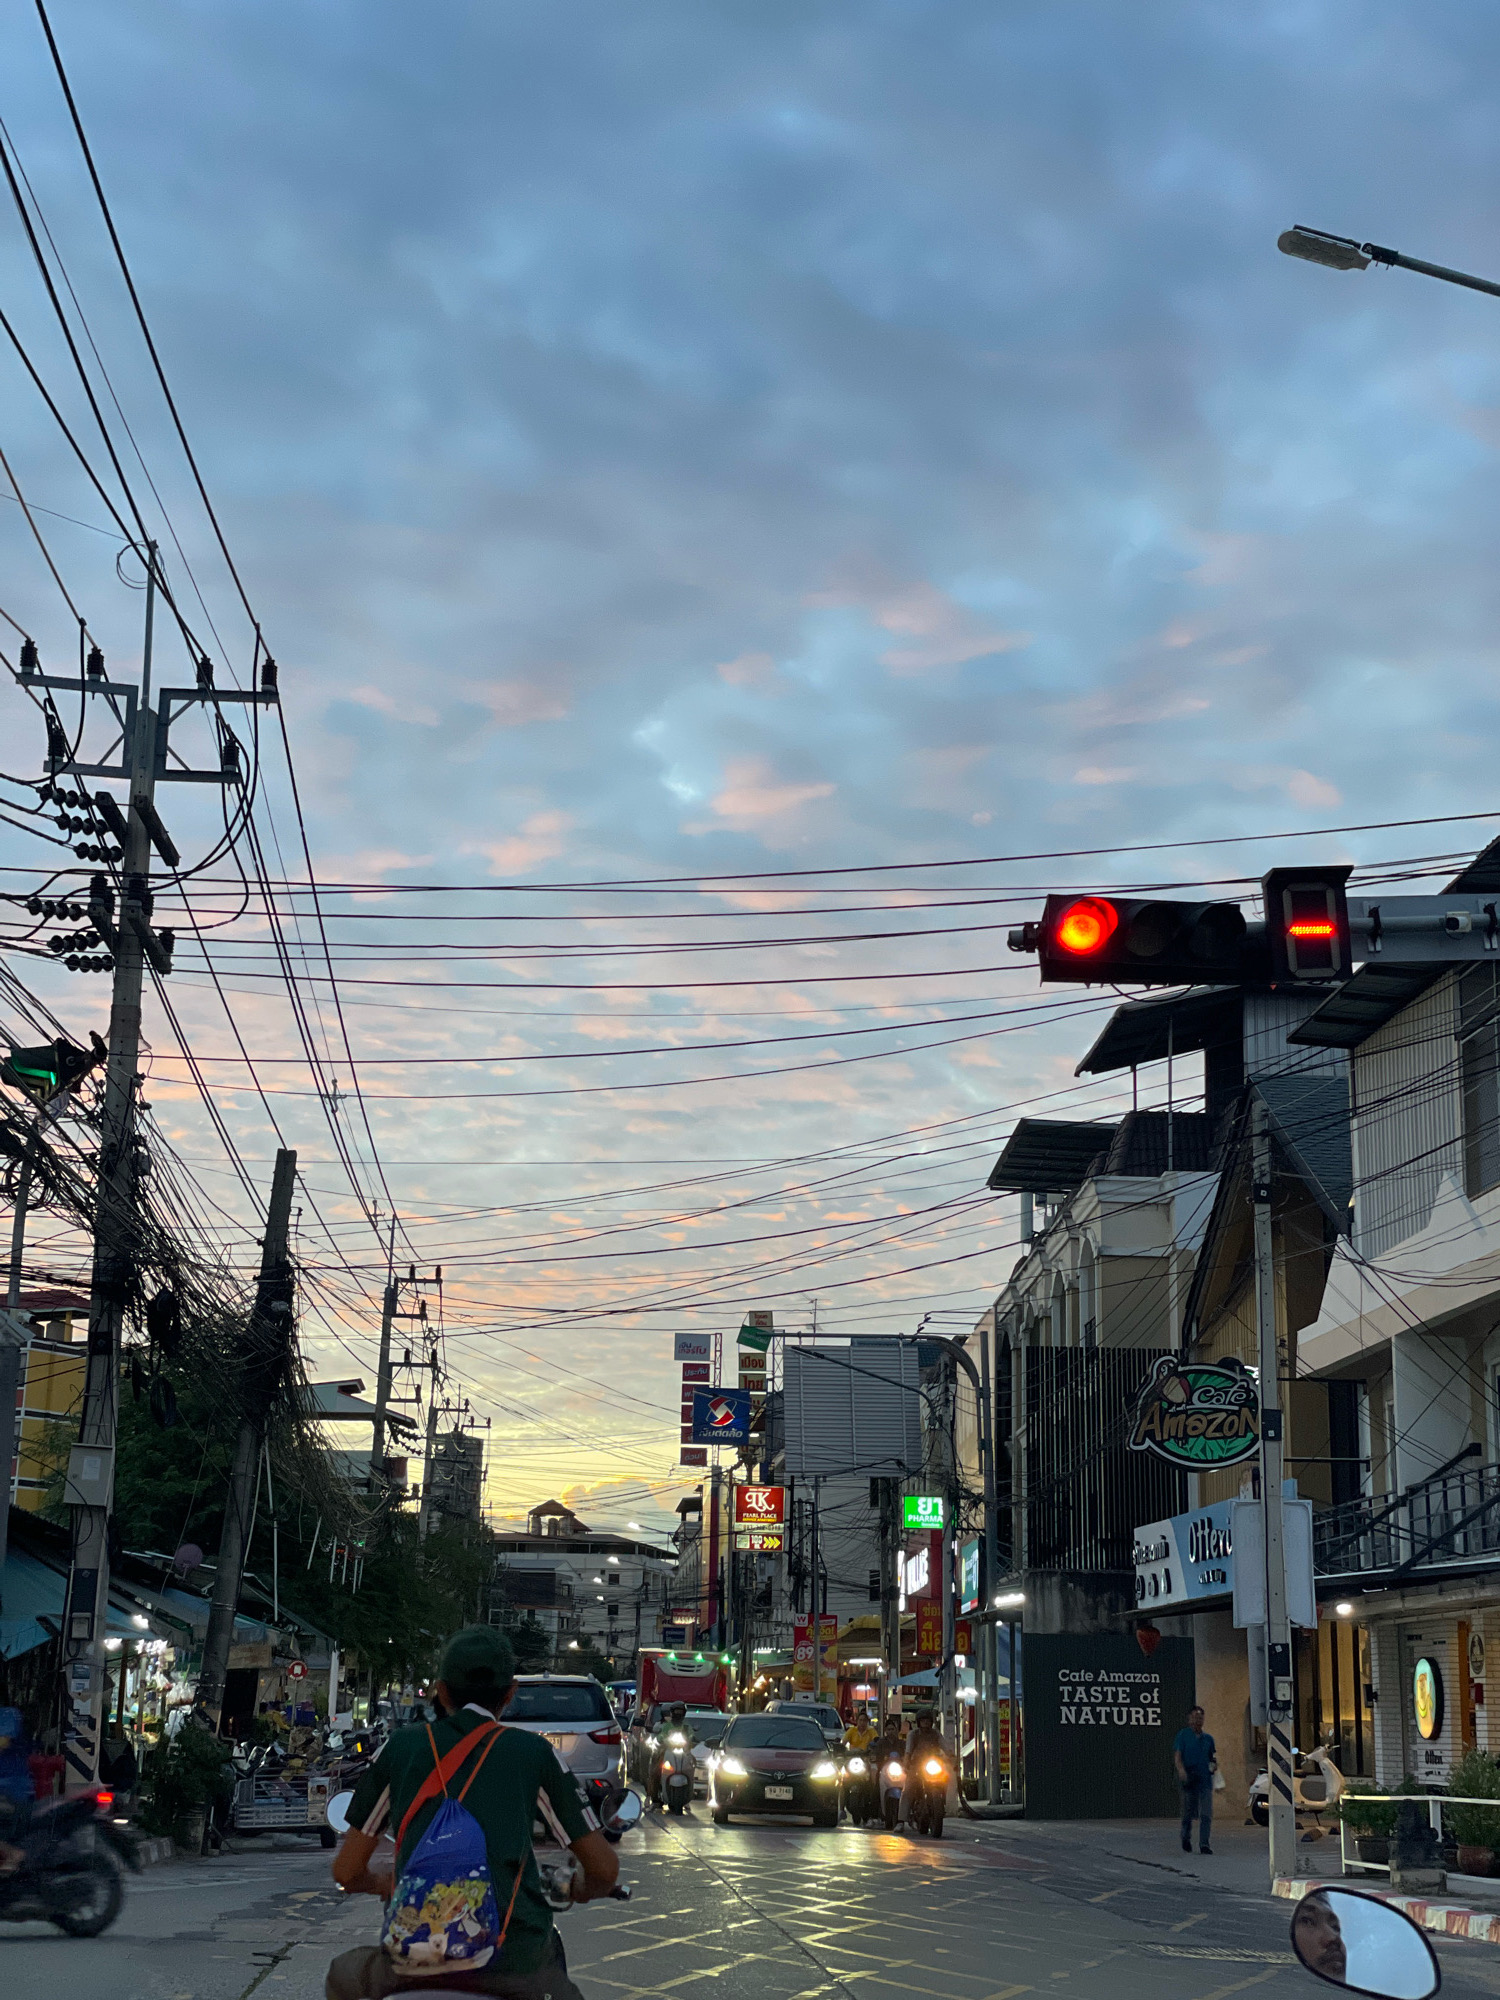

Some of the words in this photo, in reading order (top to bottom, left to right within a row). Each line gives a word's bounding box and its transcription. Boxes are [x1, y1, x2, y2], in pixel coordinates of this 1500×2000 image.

[917, 1497, 944, 1515] ยา
[908, 1514, 944, 1523] PHARMA
[796, 1646, 815, 1661] 89
[1058, 1669, 1094, 1682] Cafe
[1097, 1669, 1160, 1683] Amazon
[1059, 1686, 1131, 1703] TASTE
[1139, 1688, 1160, 1704] of
[1060, 1706, 1162, 1726] NATURE
